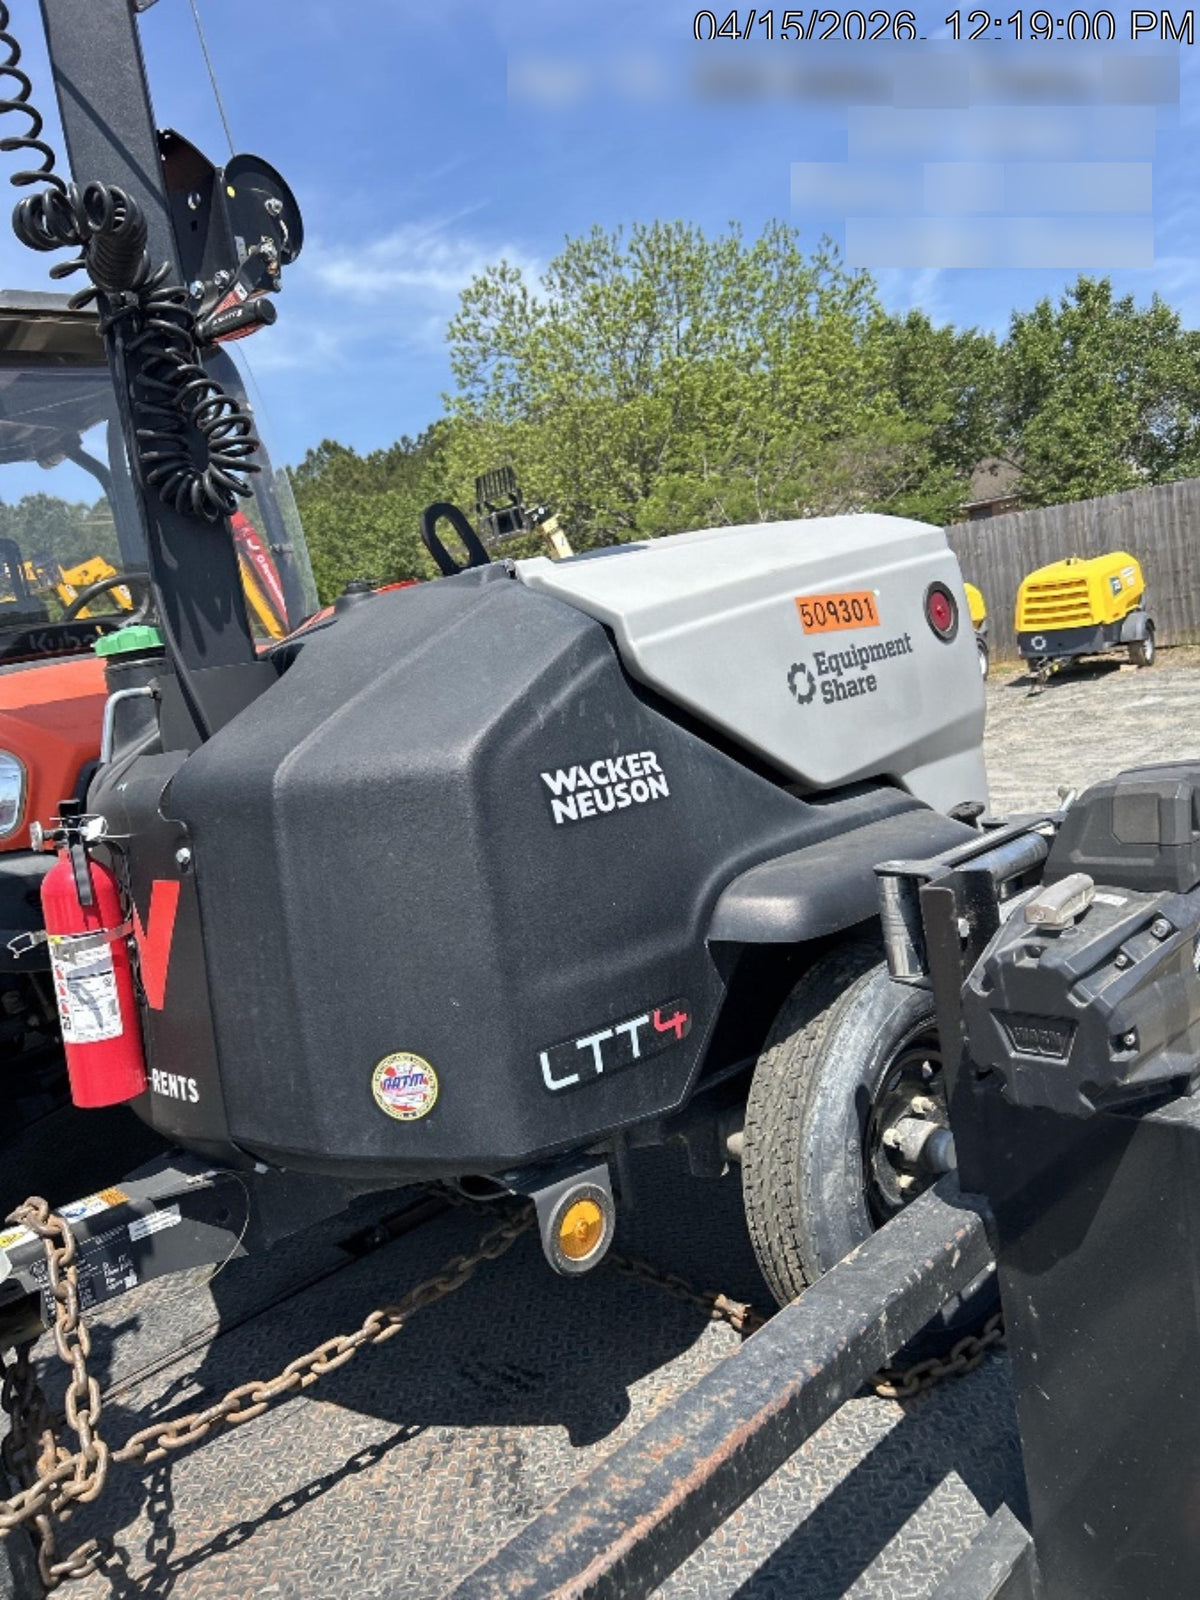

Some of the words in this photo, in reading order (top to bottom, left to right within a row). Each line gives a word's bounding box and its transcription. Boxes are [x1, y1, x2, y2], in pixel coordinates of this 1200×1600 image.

[799, 597, 875, 628] 509301
[812, 632, 914, 677] Equipment
[820, 673, 878, 705] Share
[540, 750, 664, 796] WACKER
[550, 773, 672, 825] NEUSON
[539, 1008, 689, 1091] LTT4
